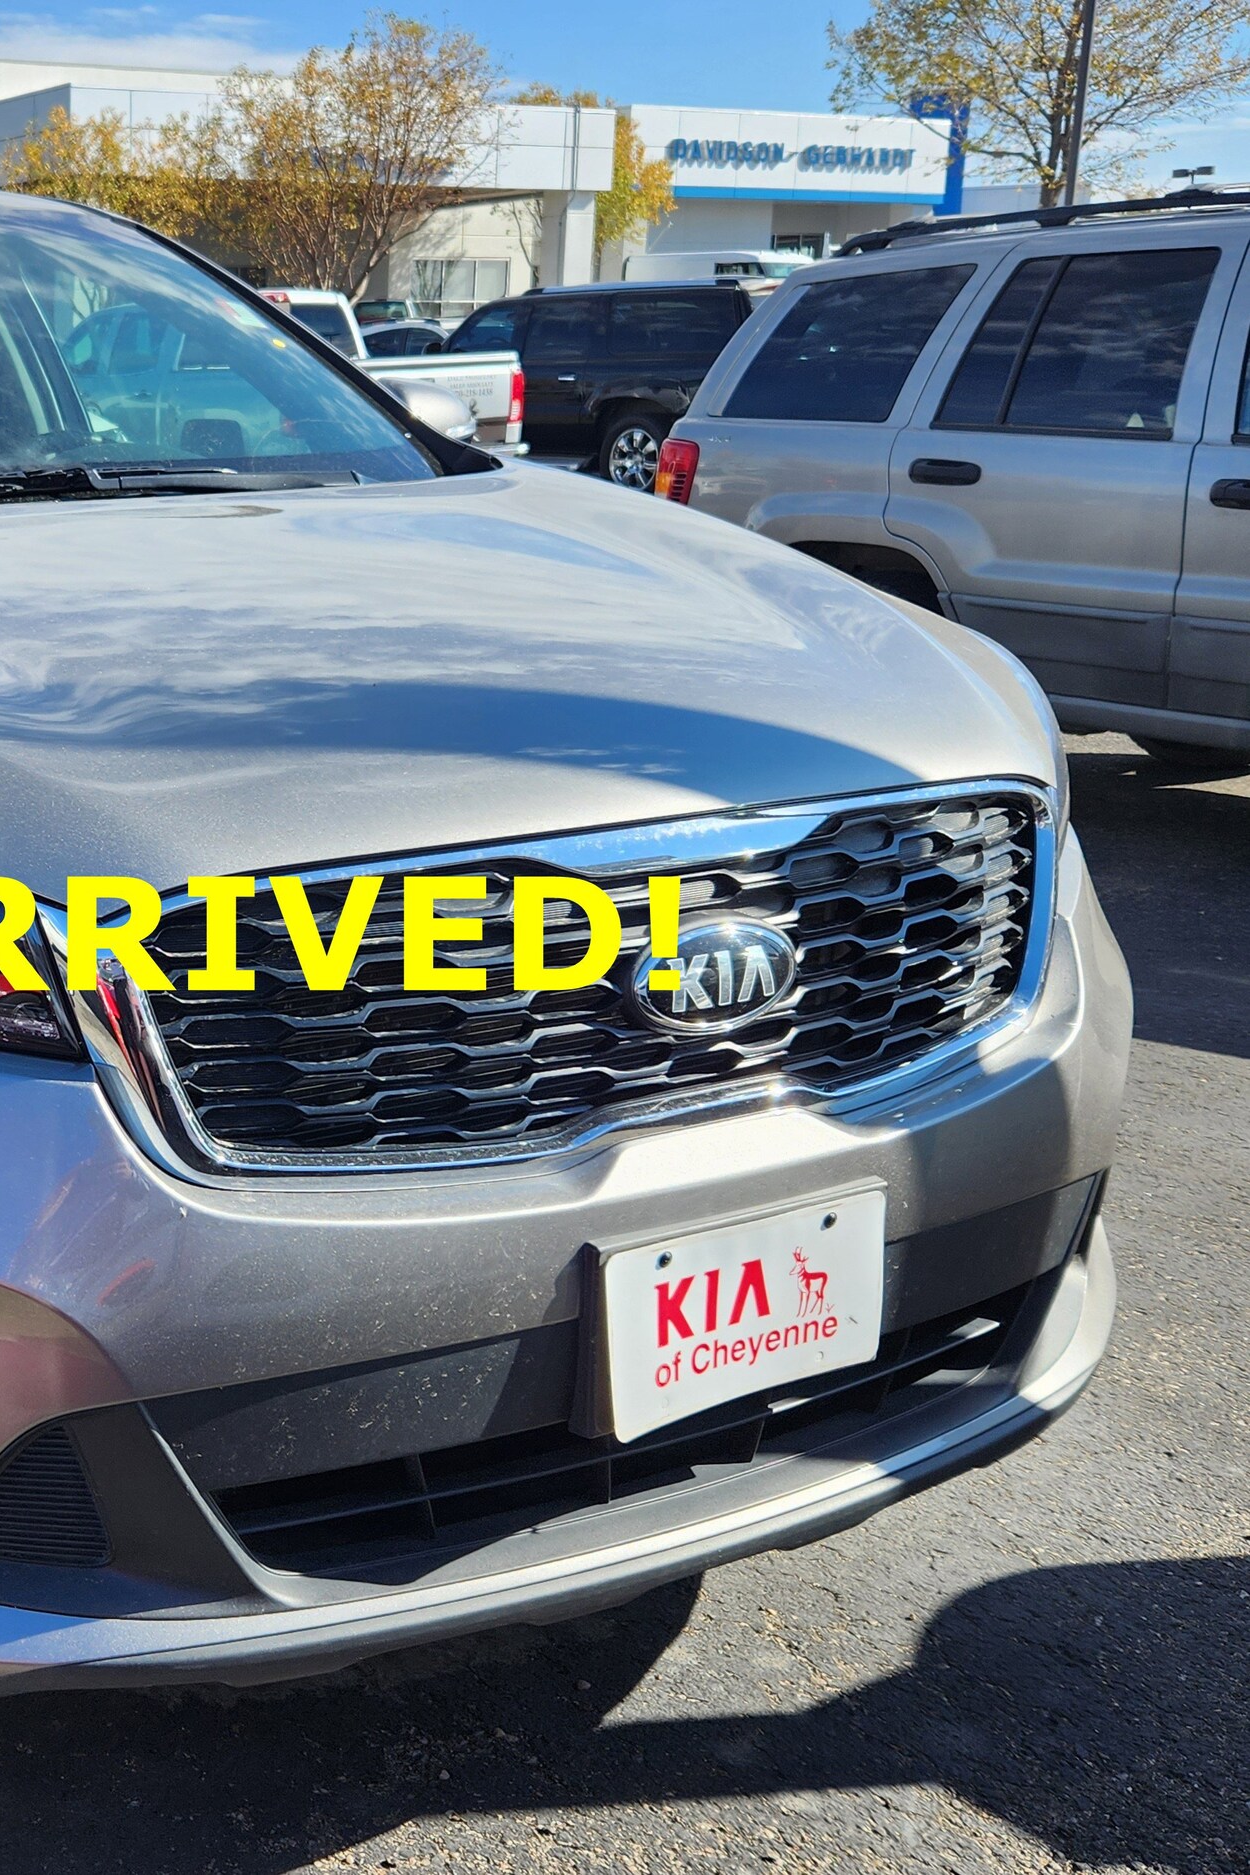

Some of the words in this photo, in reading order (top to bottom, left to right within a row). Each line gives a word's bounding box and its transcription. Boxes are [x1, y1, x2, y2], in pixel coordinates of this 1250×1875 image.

[667, 945, 775, 1013] KIA
[654, 1258, 771, 1348] KIA
[654, 1351, 682, 1388] of
[691, 1316, 838, 1375] Cheyenne
